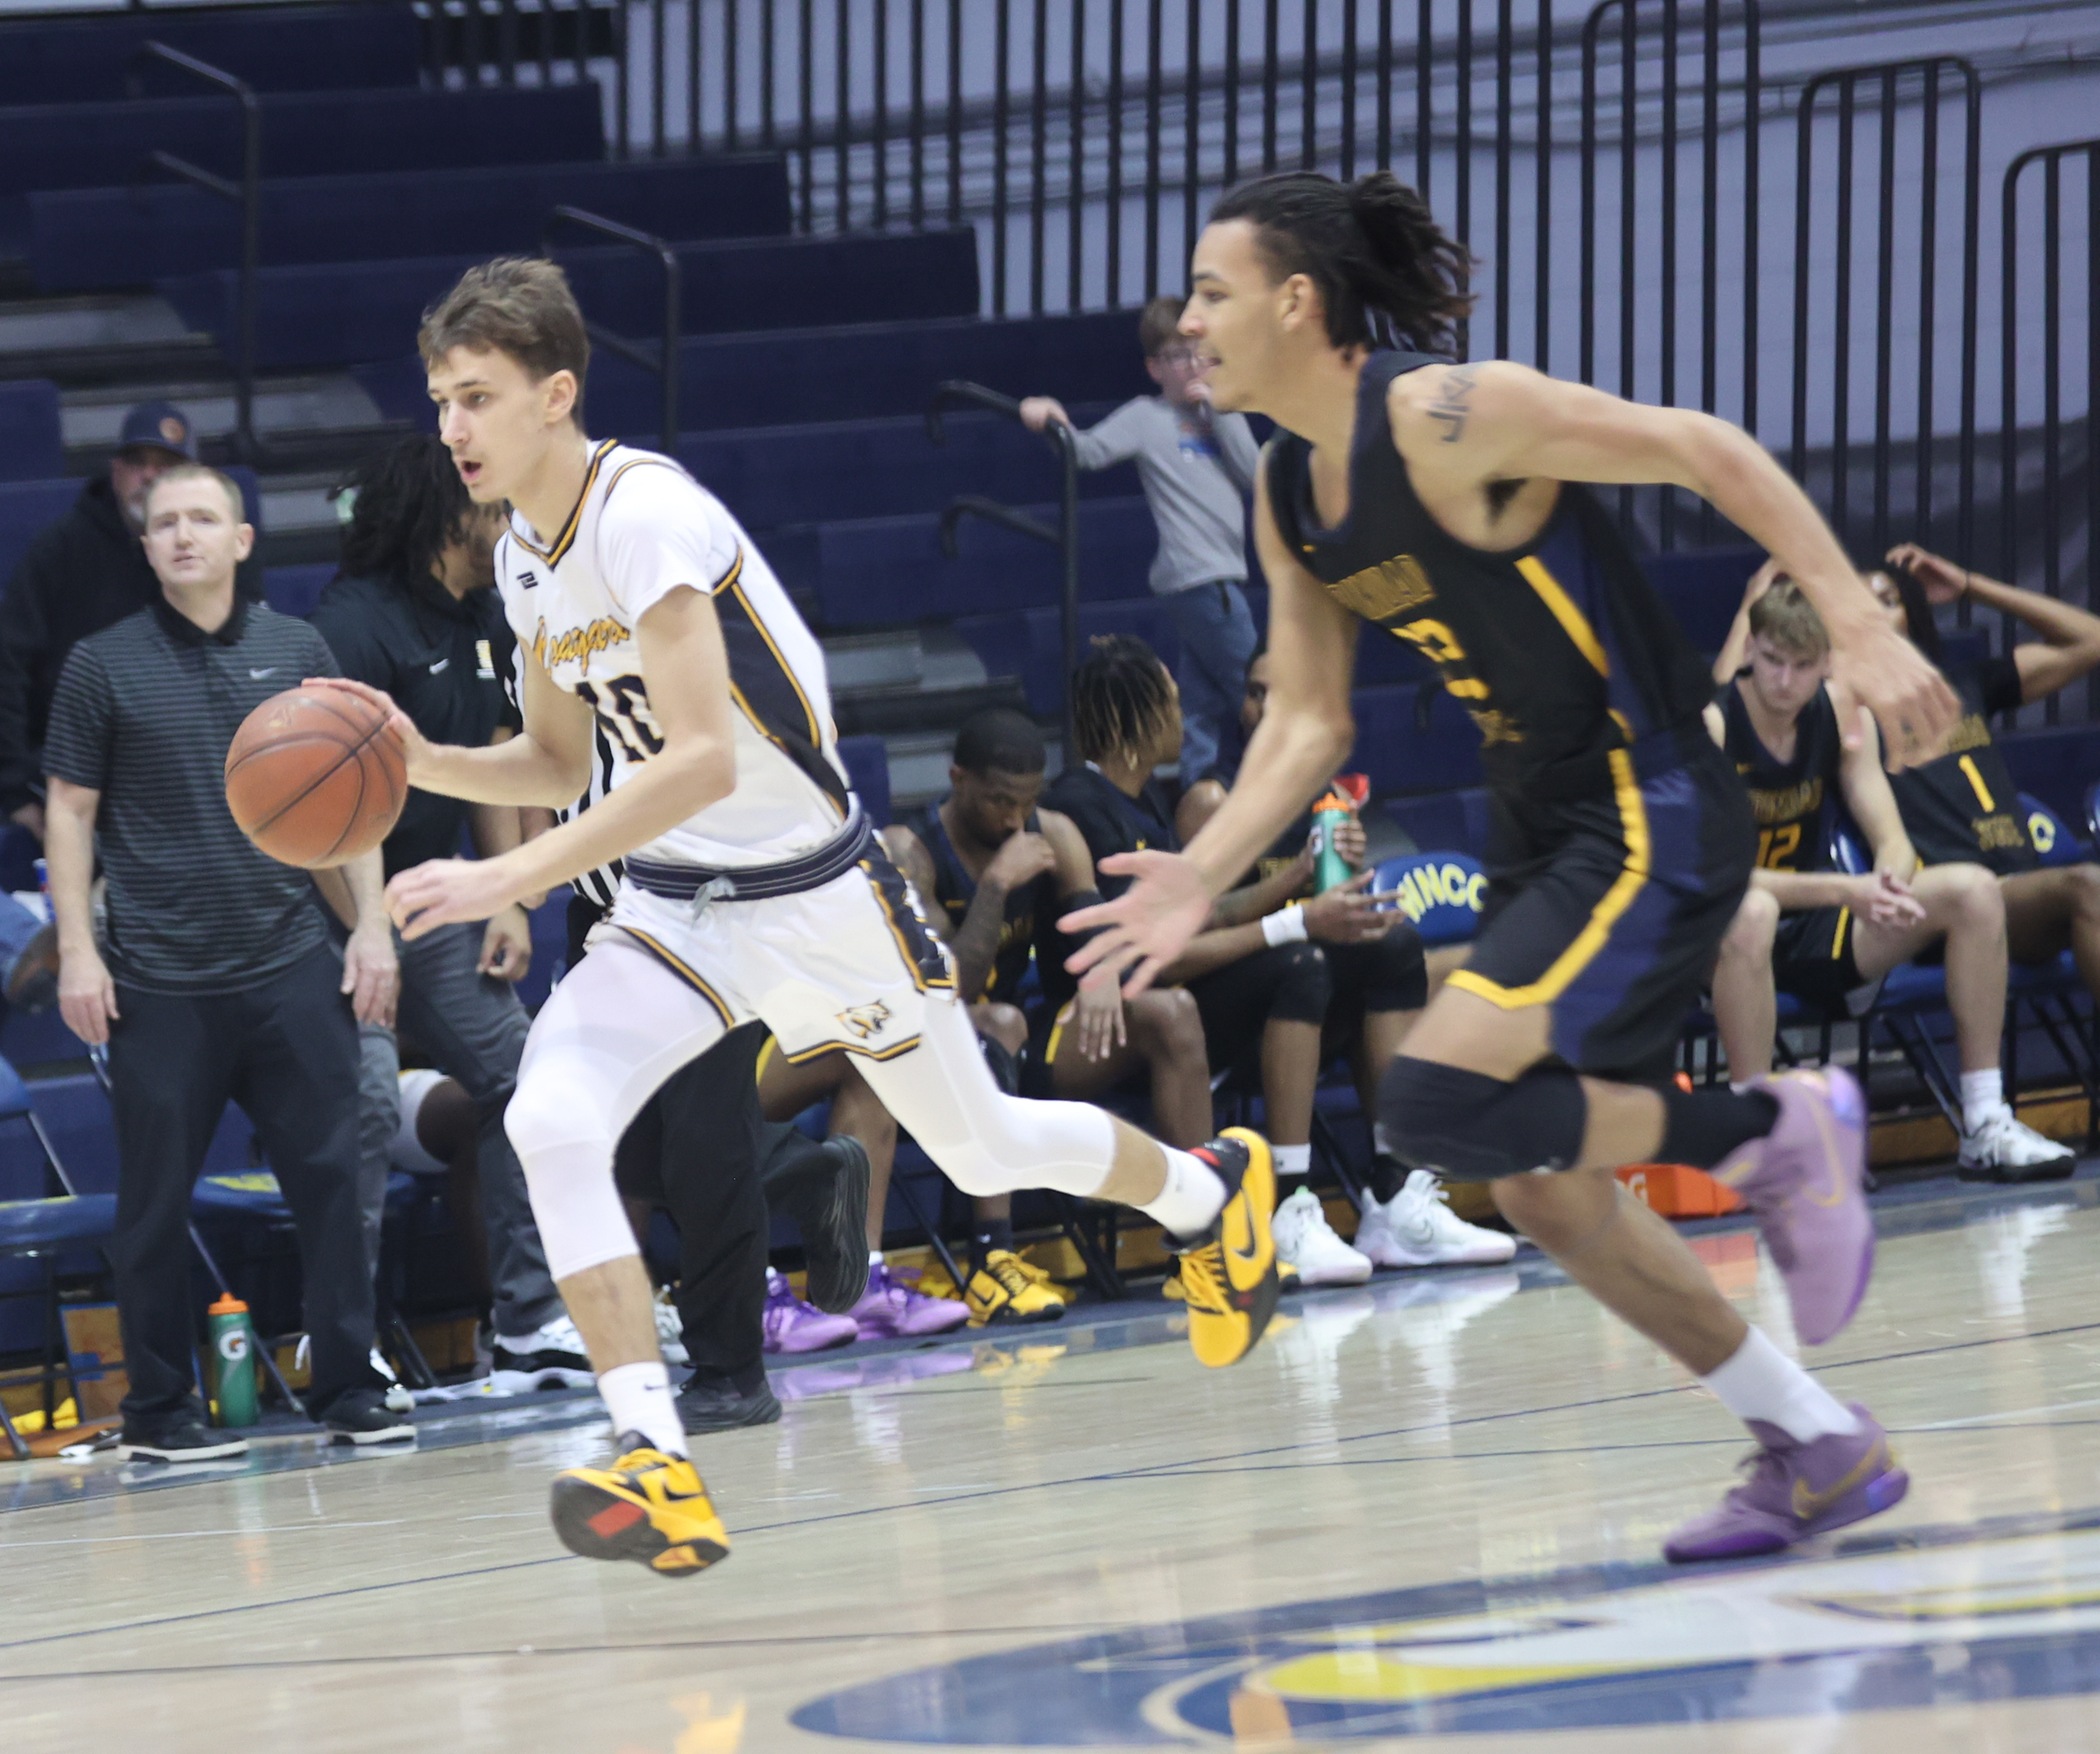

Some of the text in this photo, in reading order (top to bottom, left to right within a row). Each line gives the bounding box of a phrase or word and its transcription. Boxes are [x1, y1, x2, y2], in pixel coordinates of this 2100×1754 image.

[1958, 754, 1996, 813] 1
[1755, 822, 1802, 872] 12
[219, 1330, 247, 1361] G
